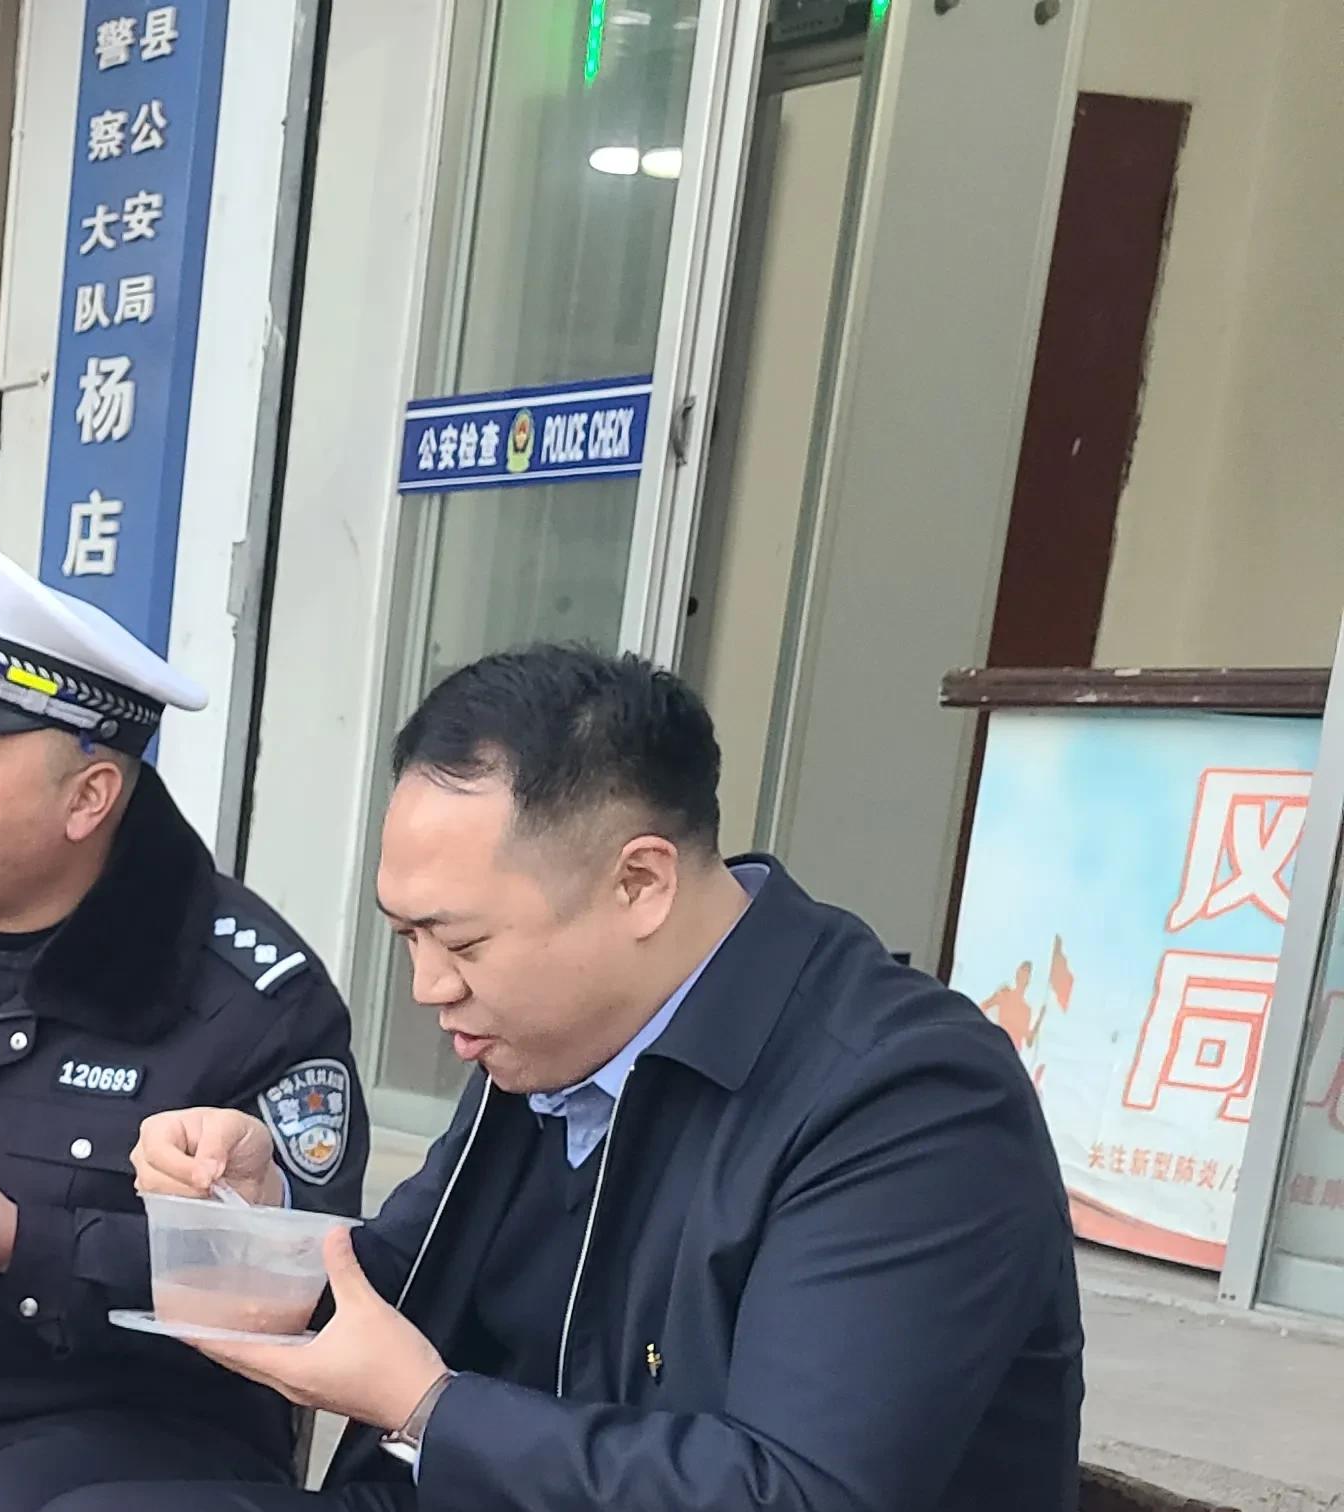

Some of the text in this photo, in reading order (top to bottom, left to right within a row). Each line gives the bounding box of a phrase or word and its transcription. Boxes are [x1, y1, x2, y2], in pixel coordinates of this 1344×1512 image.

[73, 17, 137, 333] 警察大队
[114, 6, 179, 324] 县公安局
[62, 356, 137, 578] 杨店
[418, 407, 634, 471] 公安检查 POLICE CHECK
[1088, 1142, 1241, 1192] 关注新型肺炎/
